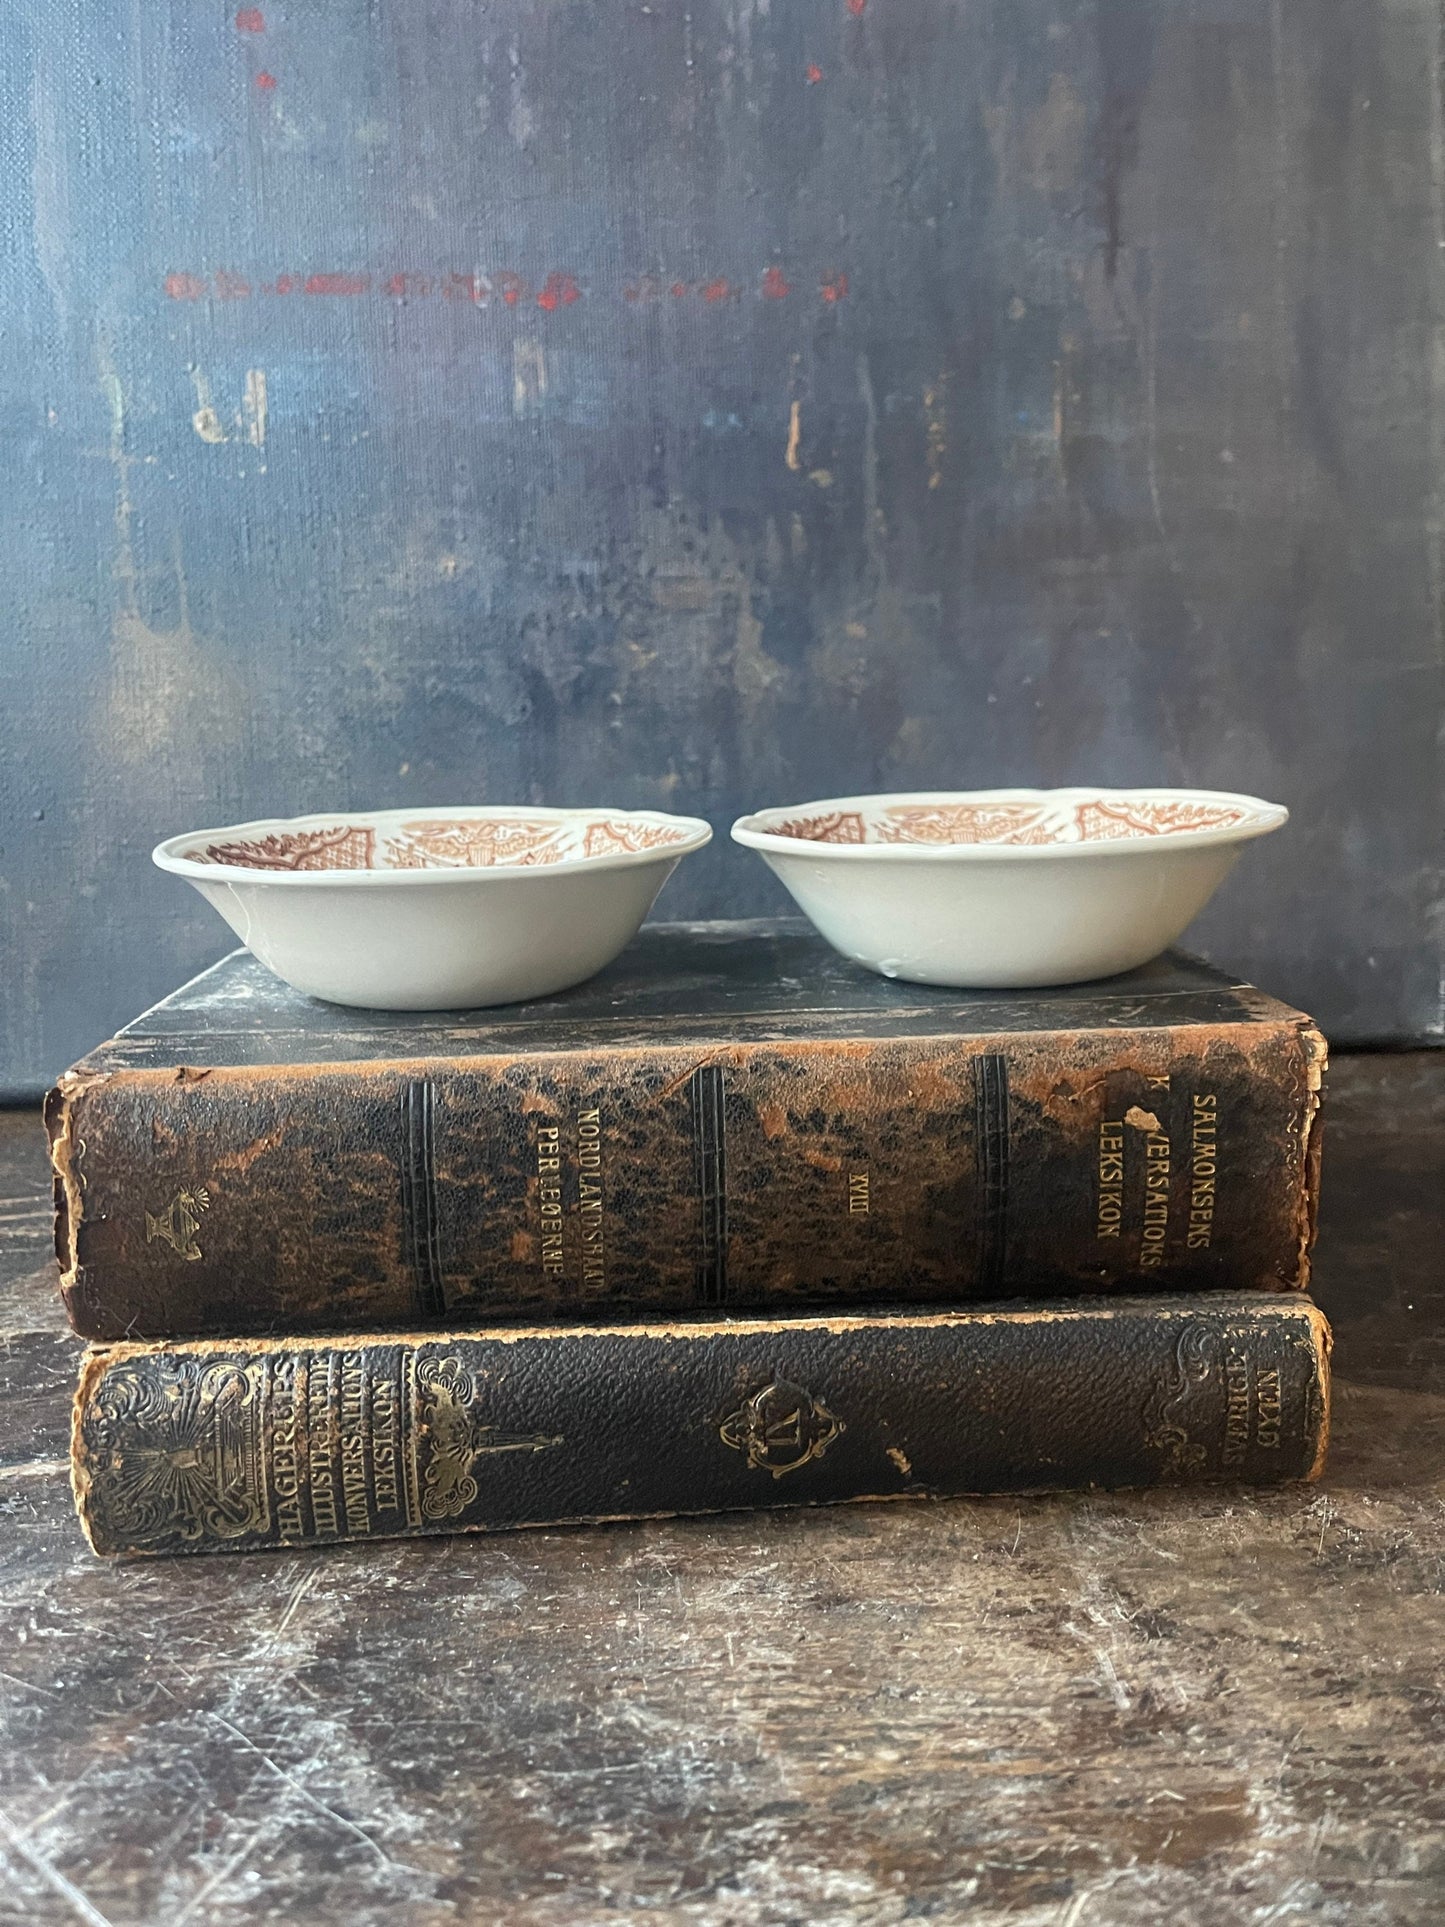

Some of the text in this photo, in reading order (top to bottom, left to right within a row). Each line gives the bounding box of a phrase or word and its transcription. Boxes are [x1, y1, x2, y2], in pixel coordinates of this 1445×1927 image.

[537, 1126, 565, 1276] PERLEØERNE
[1097, 1121, 1124, 1239] LEKSIKON
[1139, 1075, 1170, 1268] KVERSATIONS
[1187, 1094, 1217, 1249] SALMONSENS
[271, 1358, 302, 1537] HAGERUPS
[308, 1354, 338, 1536] ILLUSTREREDE
[340, 1351, 370, 1533] KONVERSATIONS
[371, 1377, 398, 1512] LEKSIKON
